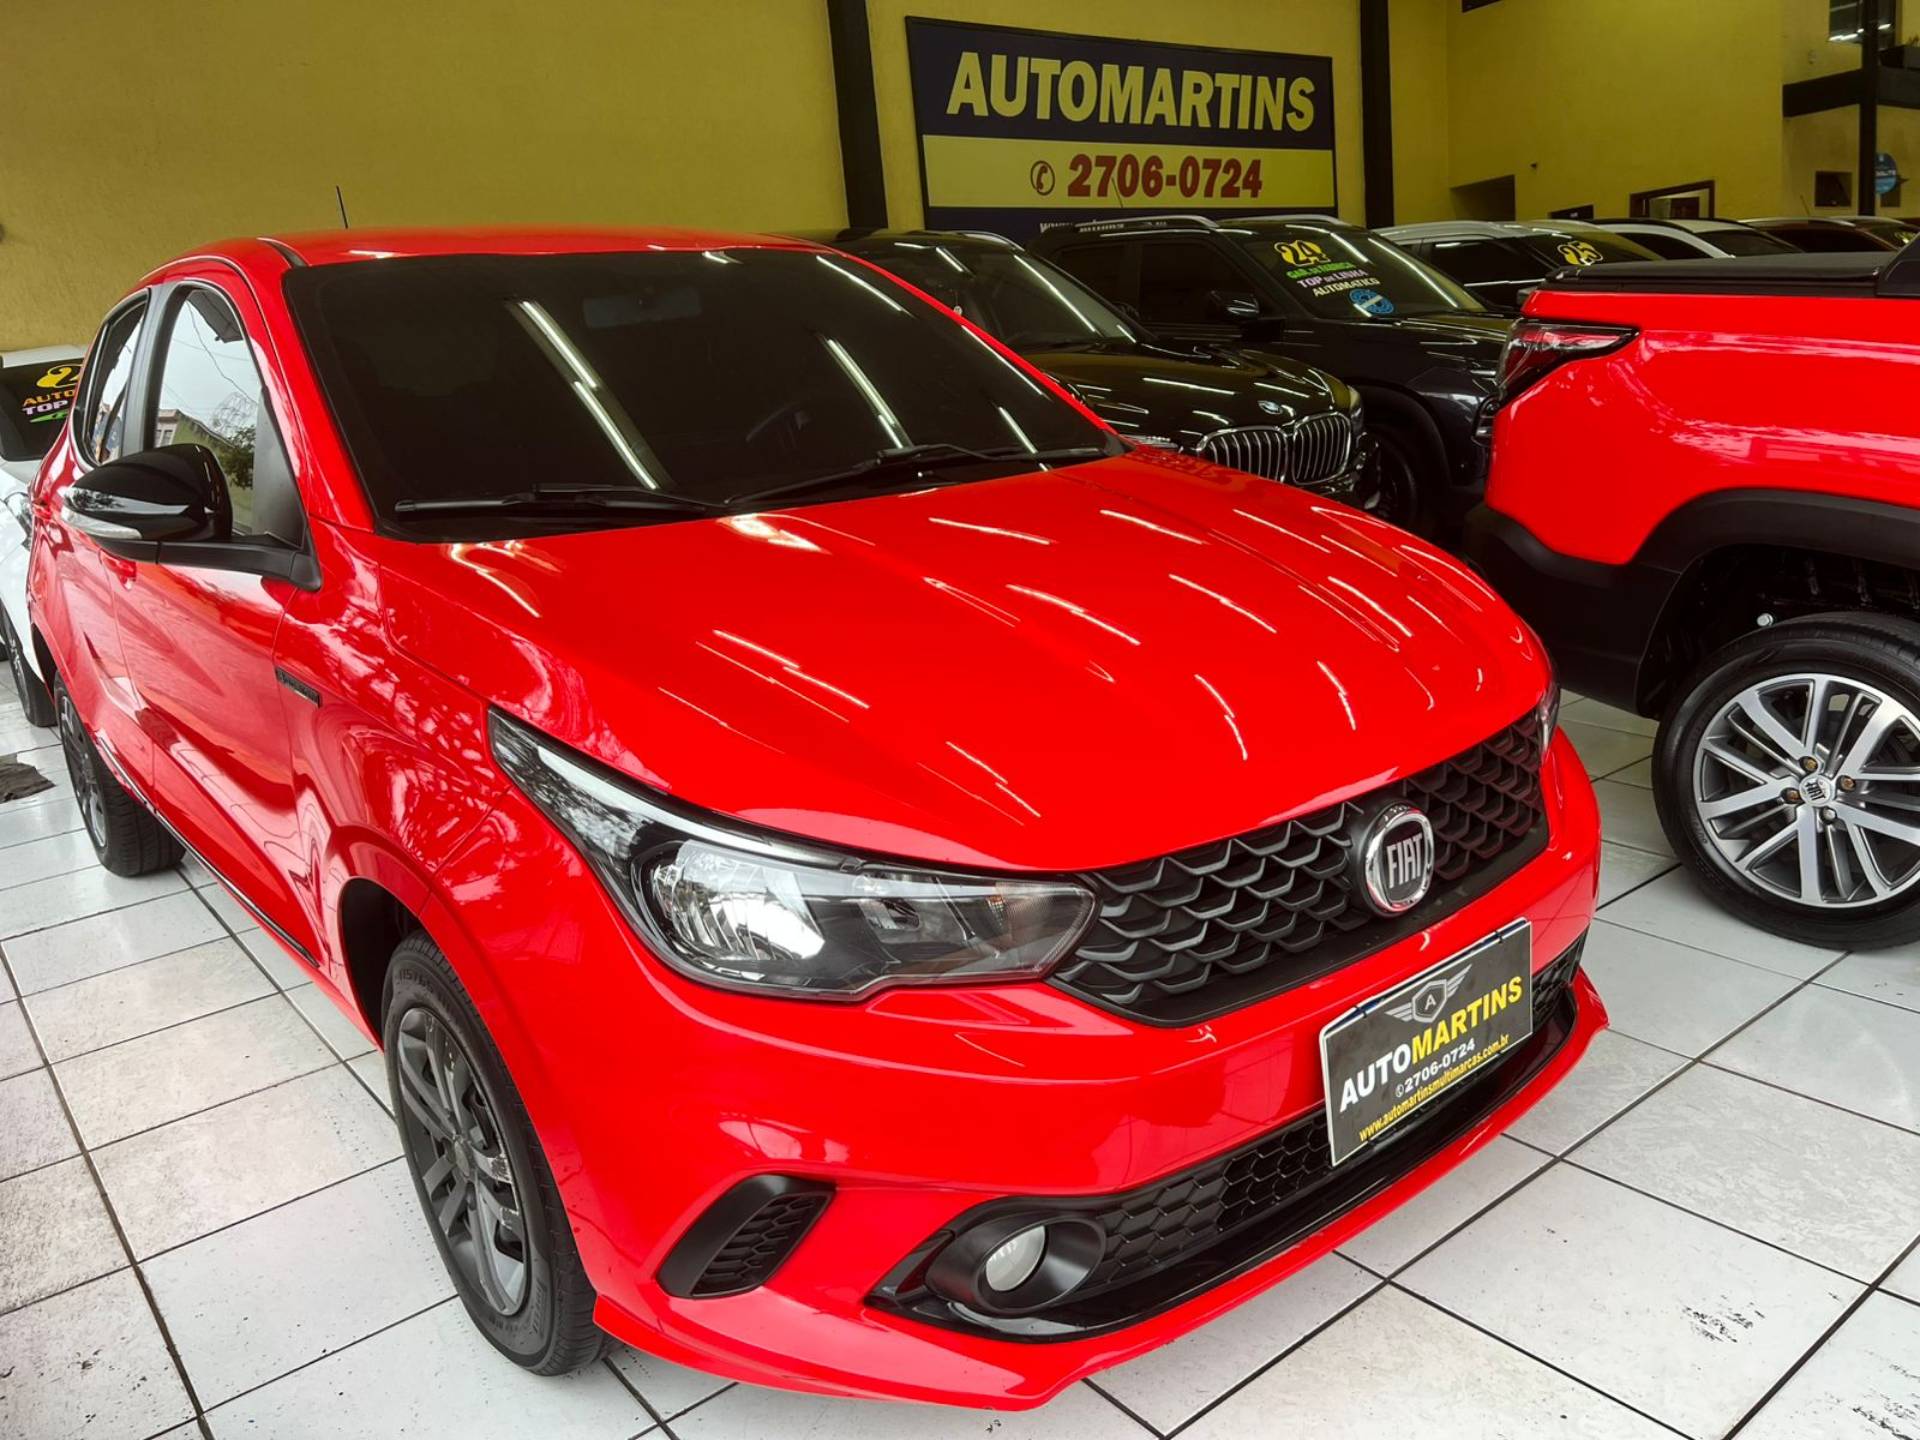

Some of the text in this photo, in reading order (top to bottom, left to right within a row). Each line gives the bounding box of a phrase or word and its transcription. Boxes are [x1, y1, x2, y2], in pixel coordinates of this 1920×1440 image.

[946, 51, 1315, 132] AUTOMARTINS
[1067, 154, 1263, 199] 2706-0724
[1274, 240, 1331, 267] 24
[1296, 275, 1323, 288] TOP
[22, 400, 69, 415] TOP
[1386, 833, 1423, 889] FIAT
[1340, 975, 1523, 1113] AUTOMARTINS
[1404, 1037, 1476, 1097] 2706-0724
[1359, 1034, 1510, 1142] www.automartinsmultimarcas.com.br
